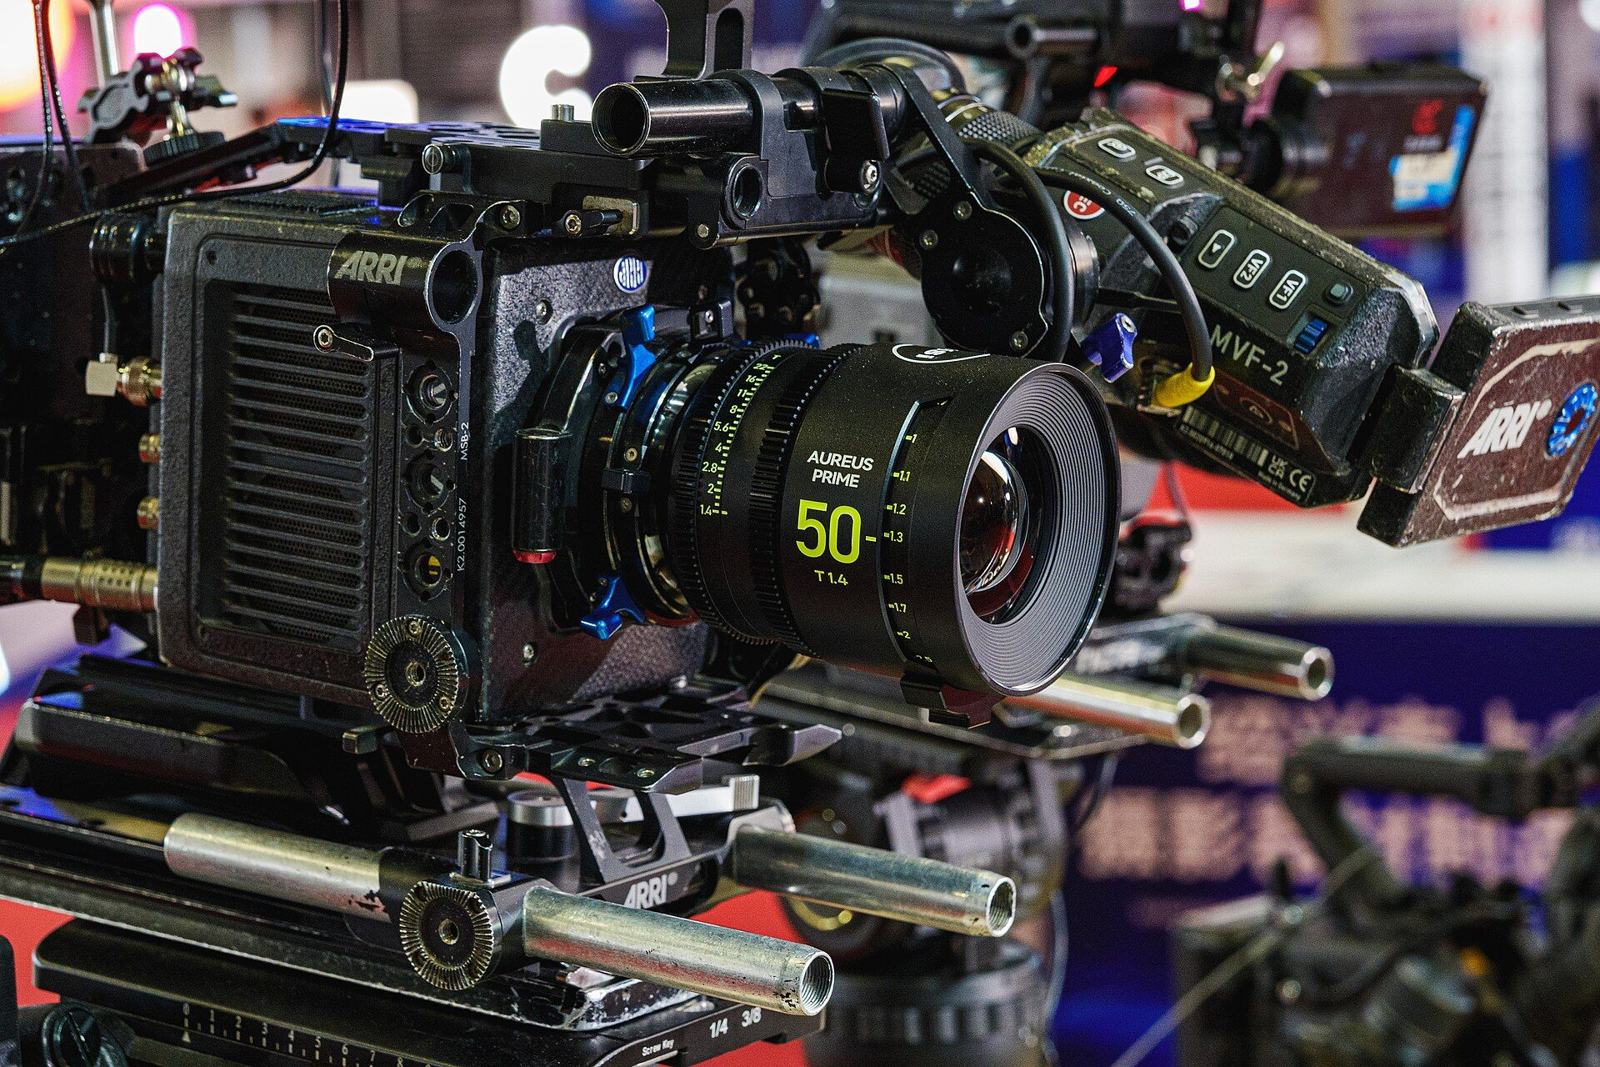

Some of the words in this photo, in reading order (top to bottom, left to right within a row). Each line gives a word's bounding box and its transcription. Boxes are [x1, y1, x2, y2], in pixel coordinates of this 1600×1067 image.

[1072, 195, 1093, 213] EC
[334, 250, 408, 286] ARRI
[1239, 258, 1264, 282] VF2
[1276, 279, 1300, 302] VF1
[1210, 324, 1289, 386] MVF-2
[745, 374, 756, 383] 16
[737, 389, 747, 397] 11
[729, 405, 738, 414] 8
[713, 422, 730, 432] 5.6
[1456, 400, 1542, 459] ARRI
[460, 421, 470, 461] MSB-2
[715, 442, 722, 453] 4
[702, 461, 718, 474] 2.8
[807, 450, 875, 472] AUREUS
[812, 468, 861, 488] PRIME
[899, 470, 911, 482] 1.1
[707, 483, 715, 494] 2
[700, 504, 712, 516] 1.4
[893, 502, 907, 515] 1.2
[457, 497, 468, 572] K2.0014957
[796, 498, 862, 564] 50
[889, 530, 904, 543] 1.3
[814, 569, 825, 582] T
[827, 572, 849, 586] 1.4
[889, 572, 904, 585] 1.5
[894, 602, 907, 614] 1.7
[902, 630, 911, 640] 2
[623, 874, 668, 909] ARRI
[741, 1007, 762, 1028] 3/8
[182, 1002, 190, 1016] 0
[235, 1015, 242, 1029] 2
[262, 1022, 268, 1035] 3
[288, 1029, 295, 1041] 4
[315, 1036, 321, 1049] 5
[341, 1043, 349, 1056] 6
[370, 1050, 376, 1062] 7
[709, 1018, 729, 1039] 1/4
